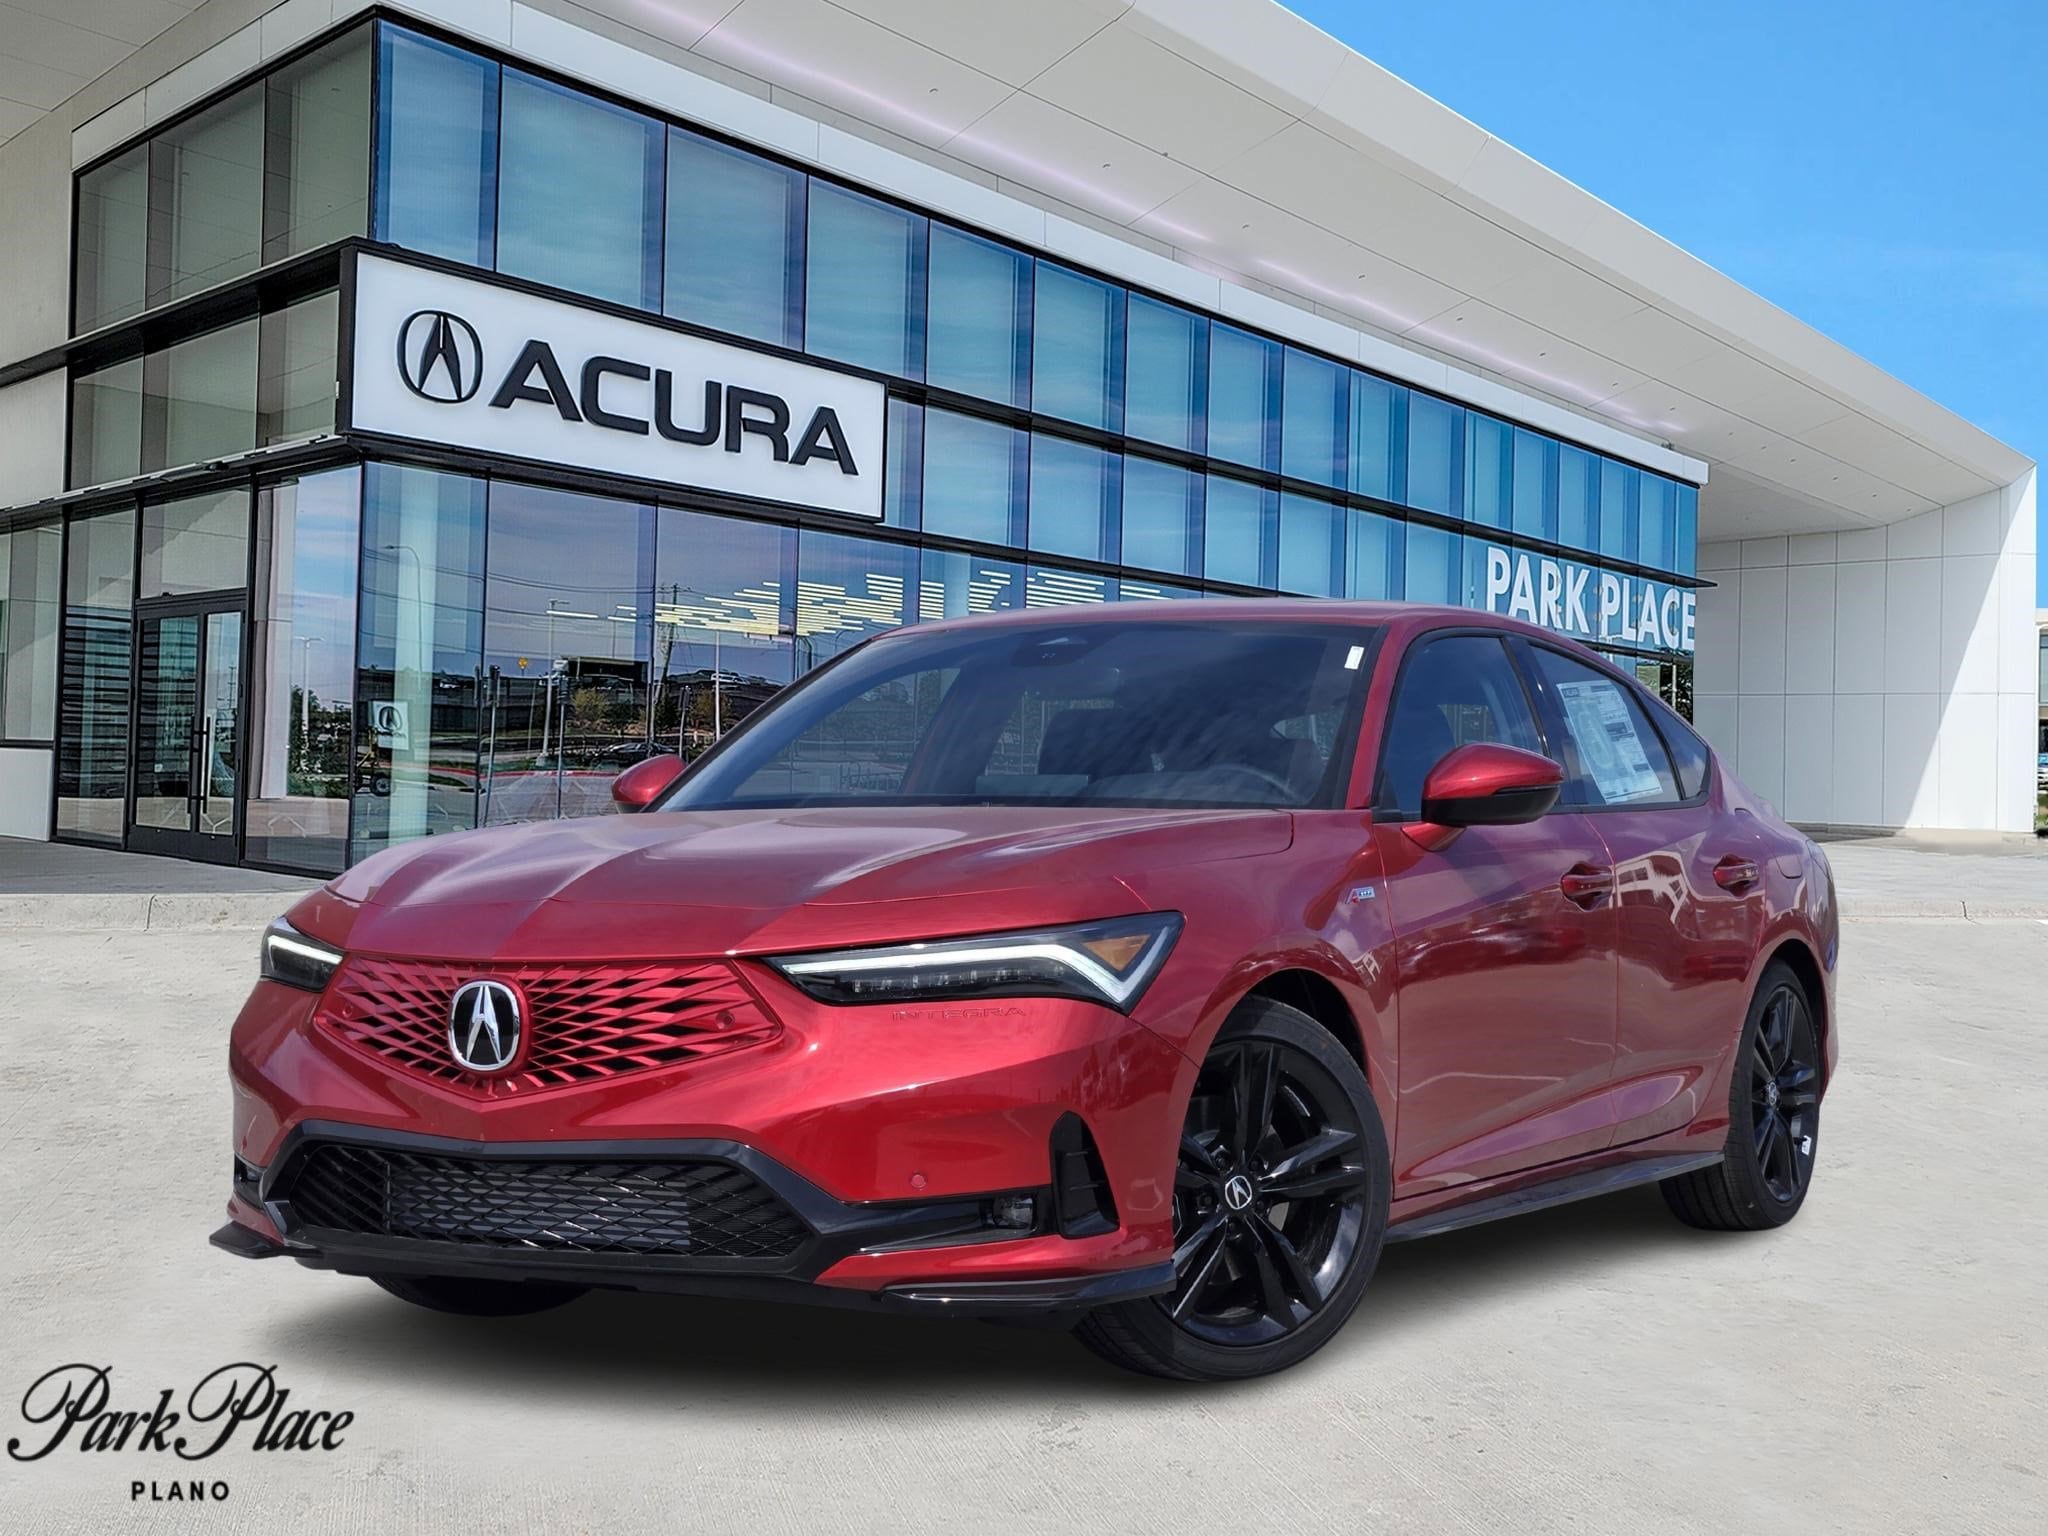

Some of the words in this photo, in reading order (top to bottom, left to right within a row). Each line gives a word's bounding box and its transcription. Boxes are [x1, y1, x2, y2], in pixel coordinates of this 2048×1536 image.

[488, 339, 859, 476] ACURA
[1486, 546, 1590, 634] PARK
[1601, 573, 1697, 650] PLACE
[891, 1007, 1026, 1021] INTEGRA
